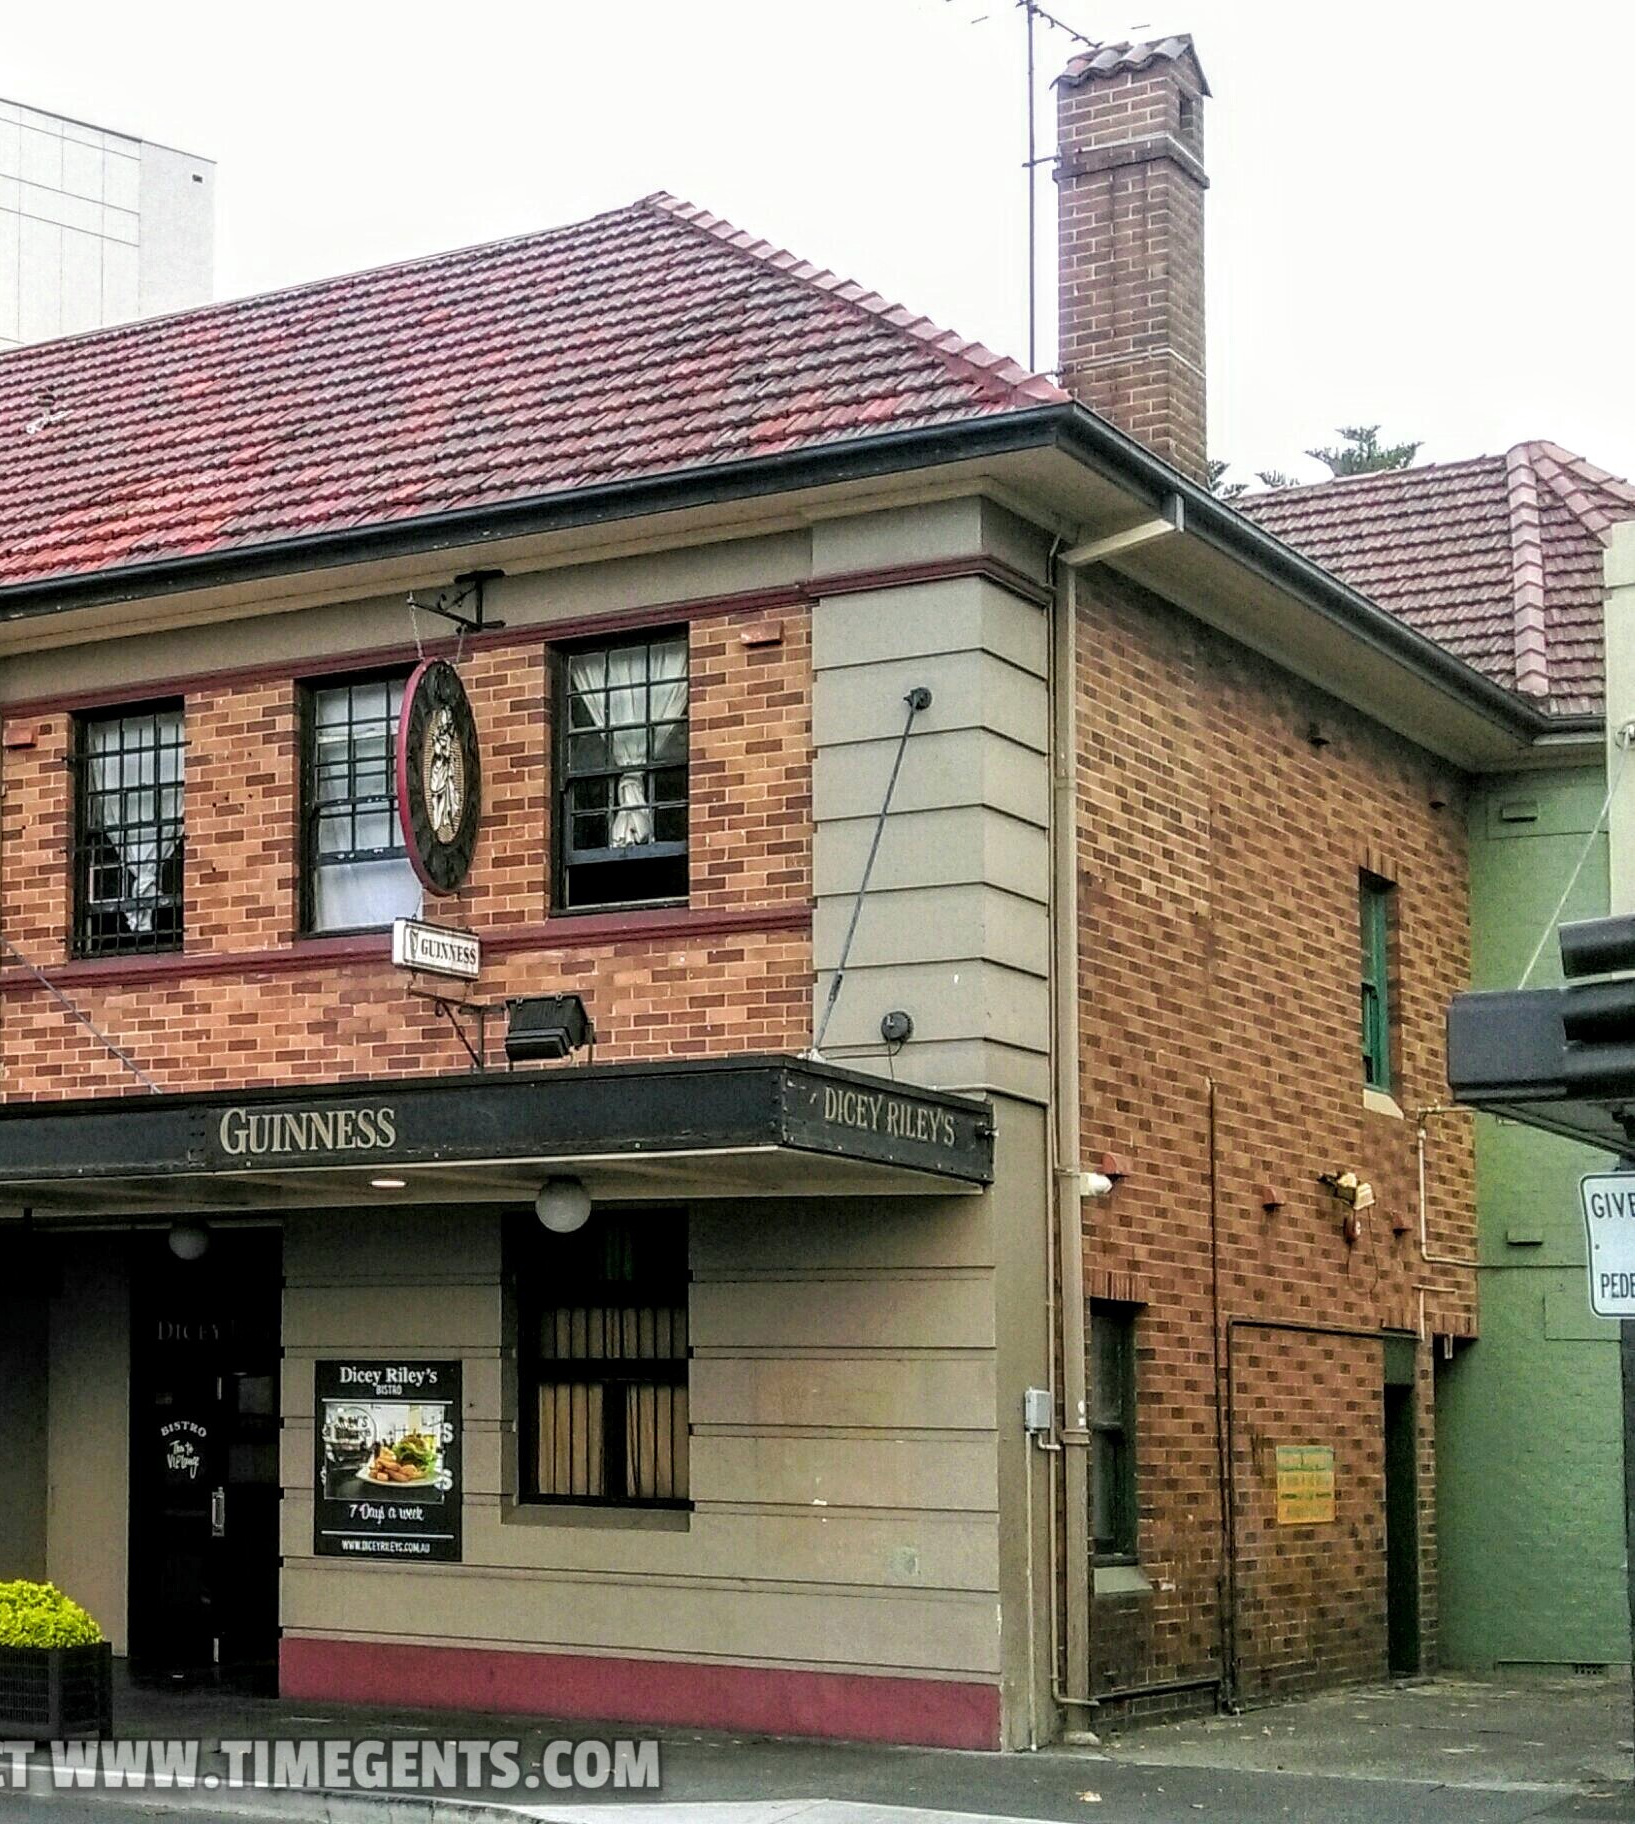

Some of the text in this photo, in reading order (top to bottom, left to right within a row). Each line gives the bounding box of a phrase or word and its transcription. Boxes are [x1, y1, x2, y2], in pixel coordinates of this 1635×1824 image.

[421, 938, 477, 966] GUINNESS
[824, 1086, 956, 1148] DICEY RILEY'S
[220, 1107, 397, 1155] GUINNESS
[1591, 1192, 1635, 1219] GIVE
[1600, 1273, 1635, 1299] PEDE
[340, 1366, 438, 1387] Dicey Riley's
[375, 1384, 403, 1396] BISTRO
[160, 1420, 207, 1438] BISTRO
[349, 1503, 425, 1524] 7 Days a week
